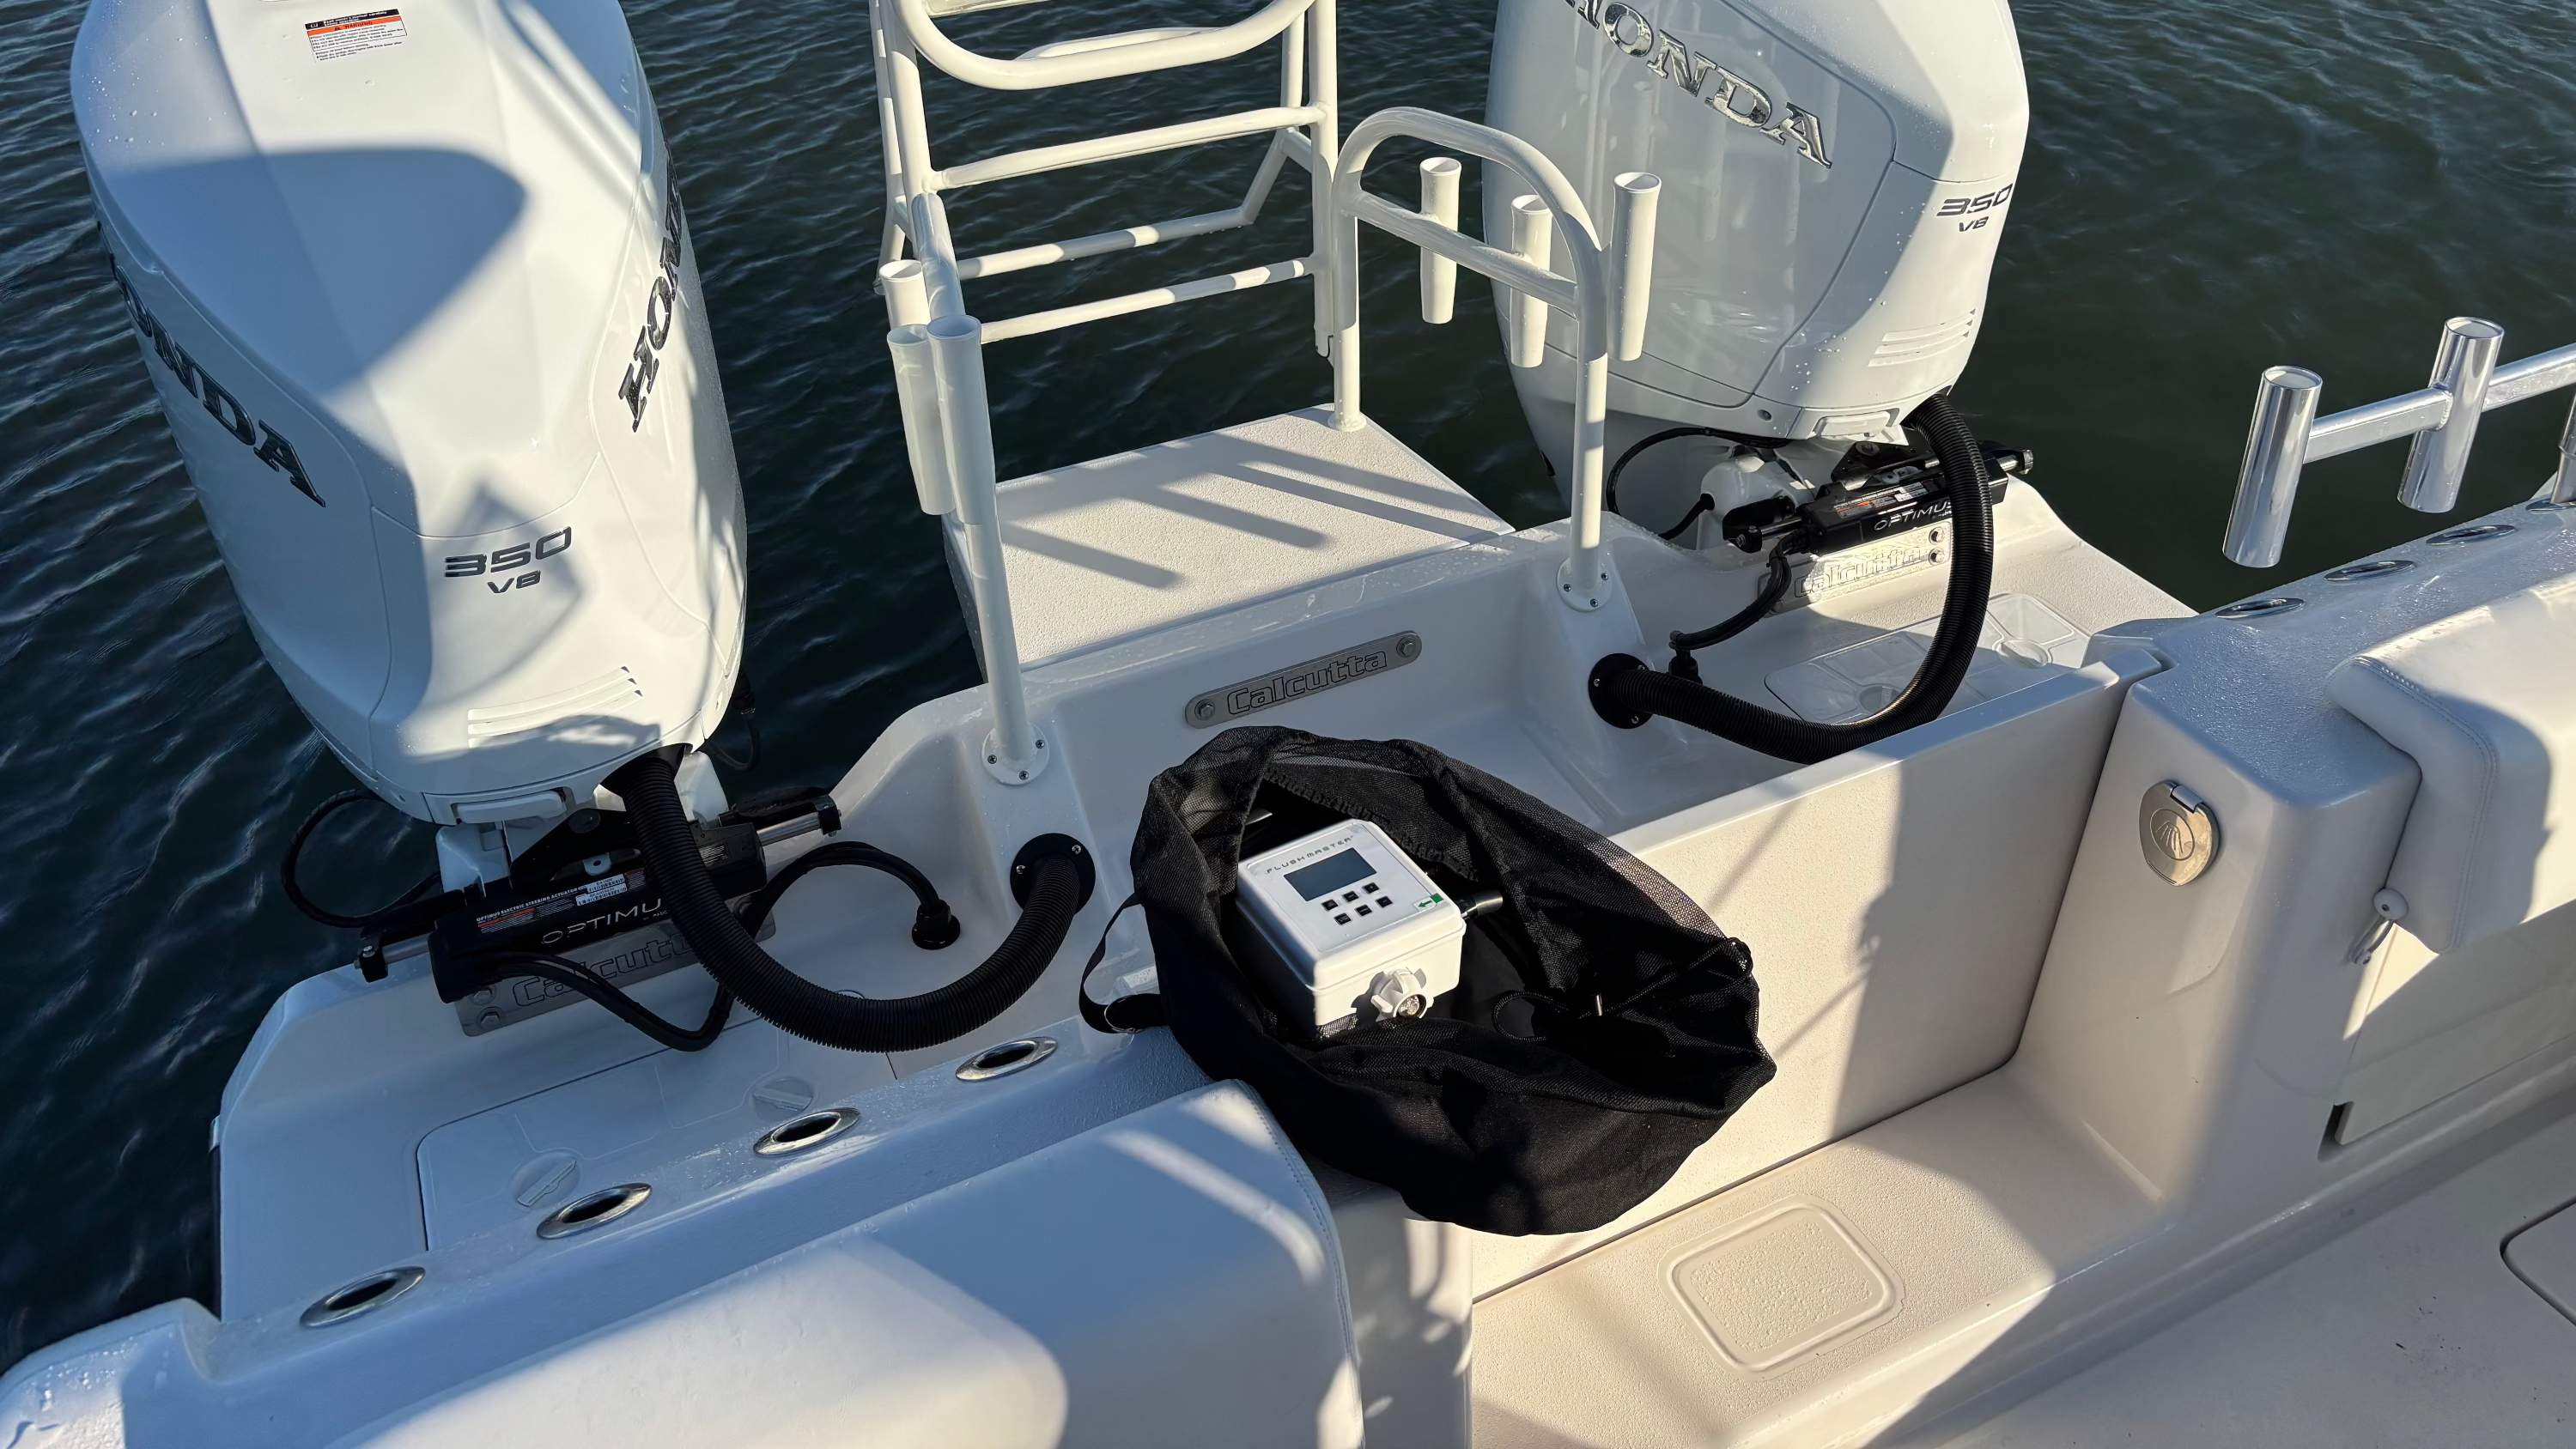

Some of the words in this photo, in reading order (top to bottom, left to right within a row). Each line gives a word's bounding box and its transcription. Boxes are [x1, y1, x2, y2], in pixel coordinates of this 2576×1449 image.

[1936, 183, 2013, 216] 350
[1959, 215, 1989, 232] V8
[96, 221, 326, 508] ONDA
[444, 526, 572, 578] 350
[487, 570, 542, 594] V8
[1226, 651, 1388, 715] Calcutta
[476, 911, 501, 923] OPTIMUS
[501, 904, 526, 915] ELECTRIC
[526, 895, 550, 907] STEERING
[550, 888, 578, 900] ACTUATOR
[541, 898, 661, 944] OPTIMU
